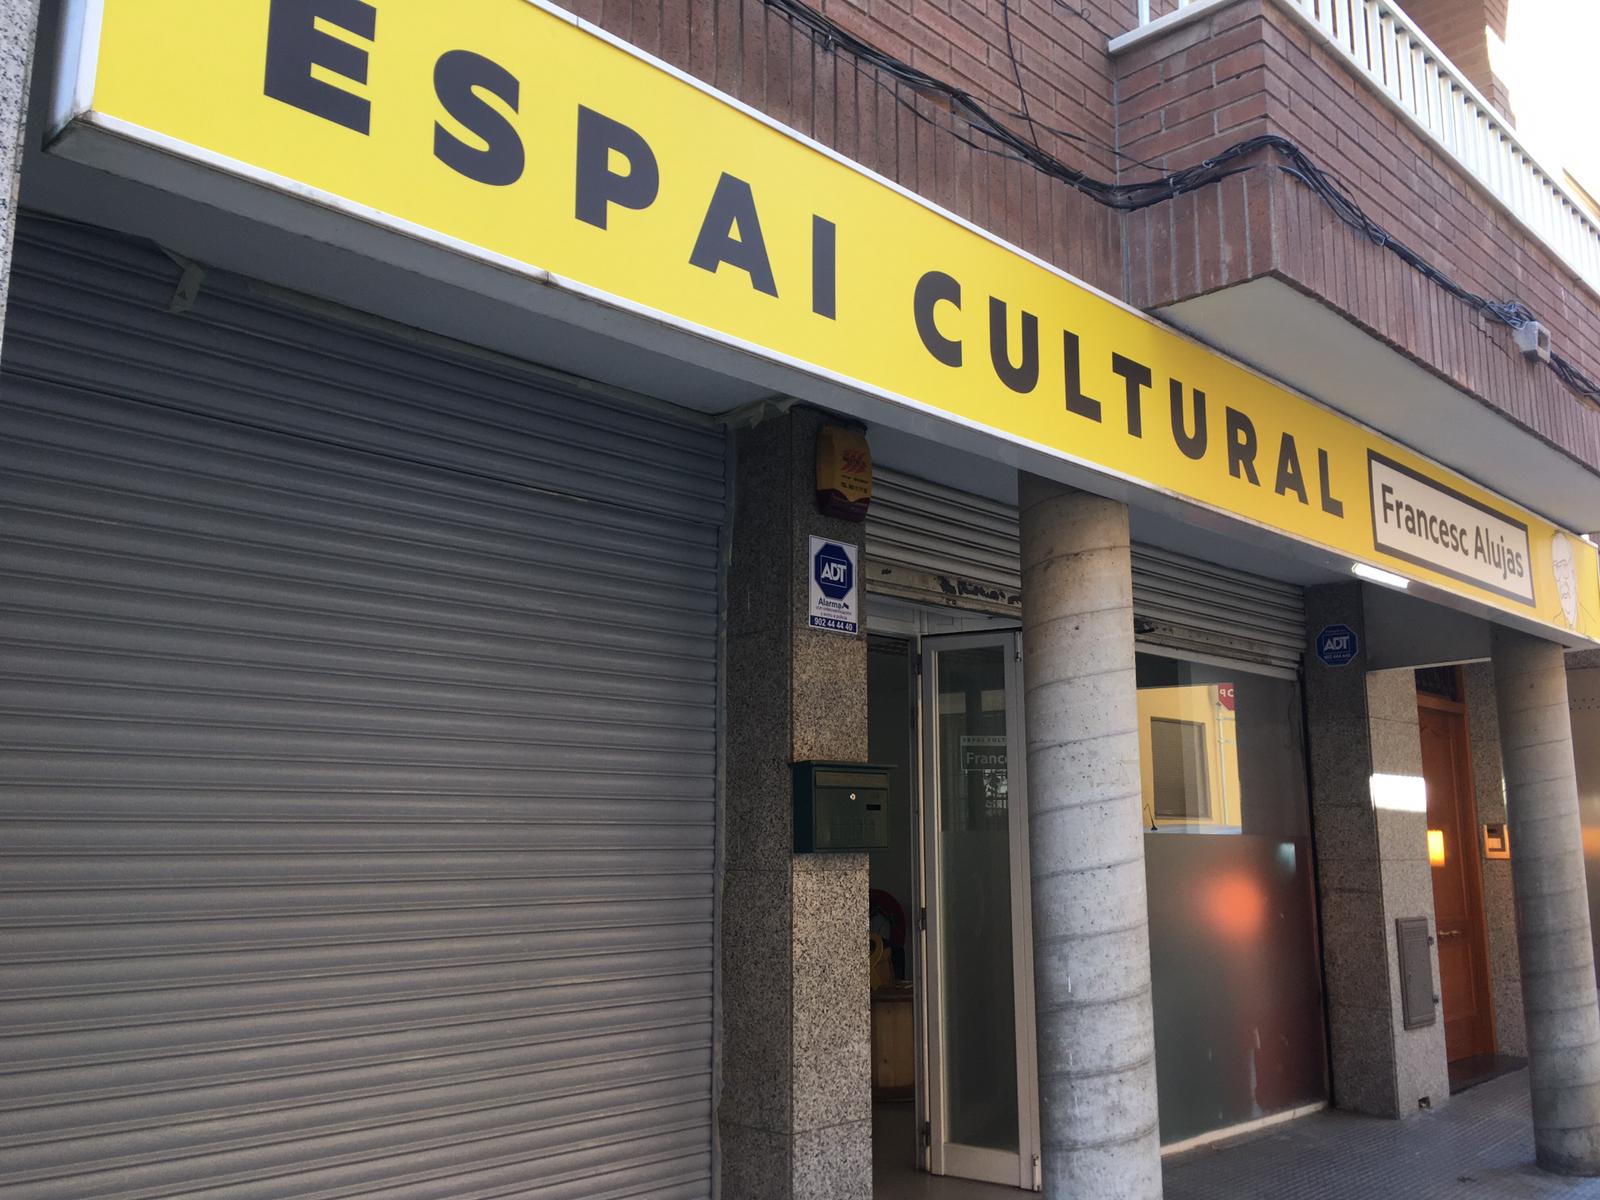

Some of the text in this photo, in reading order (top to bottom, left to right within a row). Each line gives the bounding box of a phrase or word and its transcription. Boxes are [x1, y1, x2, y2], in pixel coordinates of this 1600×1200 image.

[264, 0, 1343, 518] ESPAI CULTURAL
[1381, 483, 1524, 580] Francesc Alujas
[821, 562, 847, 583] ADT
[818, 597, 842, 609] Alarma
[814, 617, 826, 627] 902
[1323, 636, 1350, 651] ADT
[966, 752, 1008, 765] Franc
